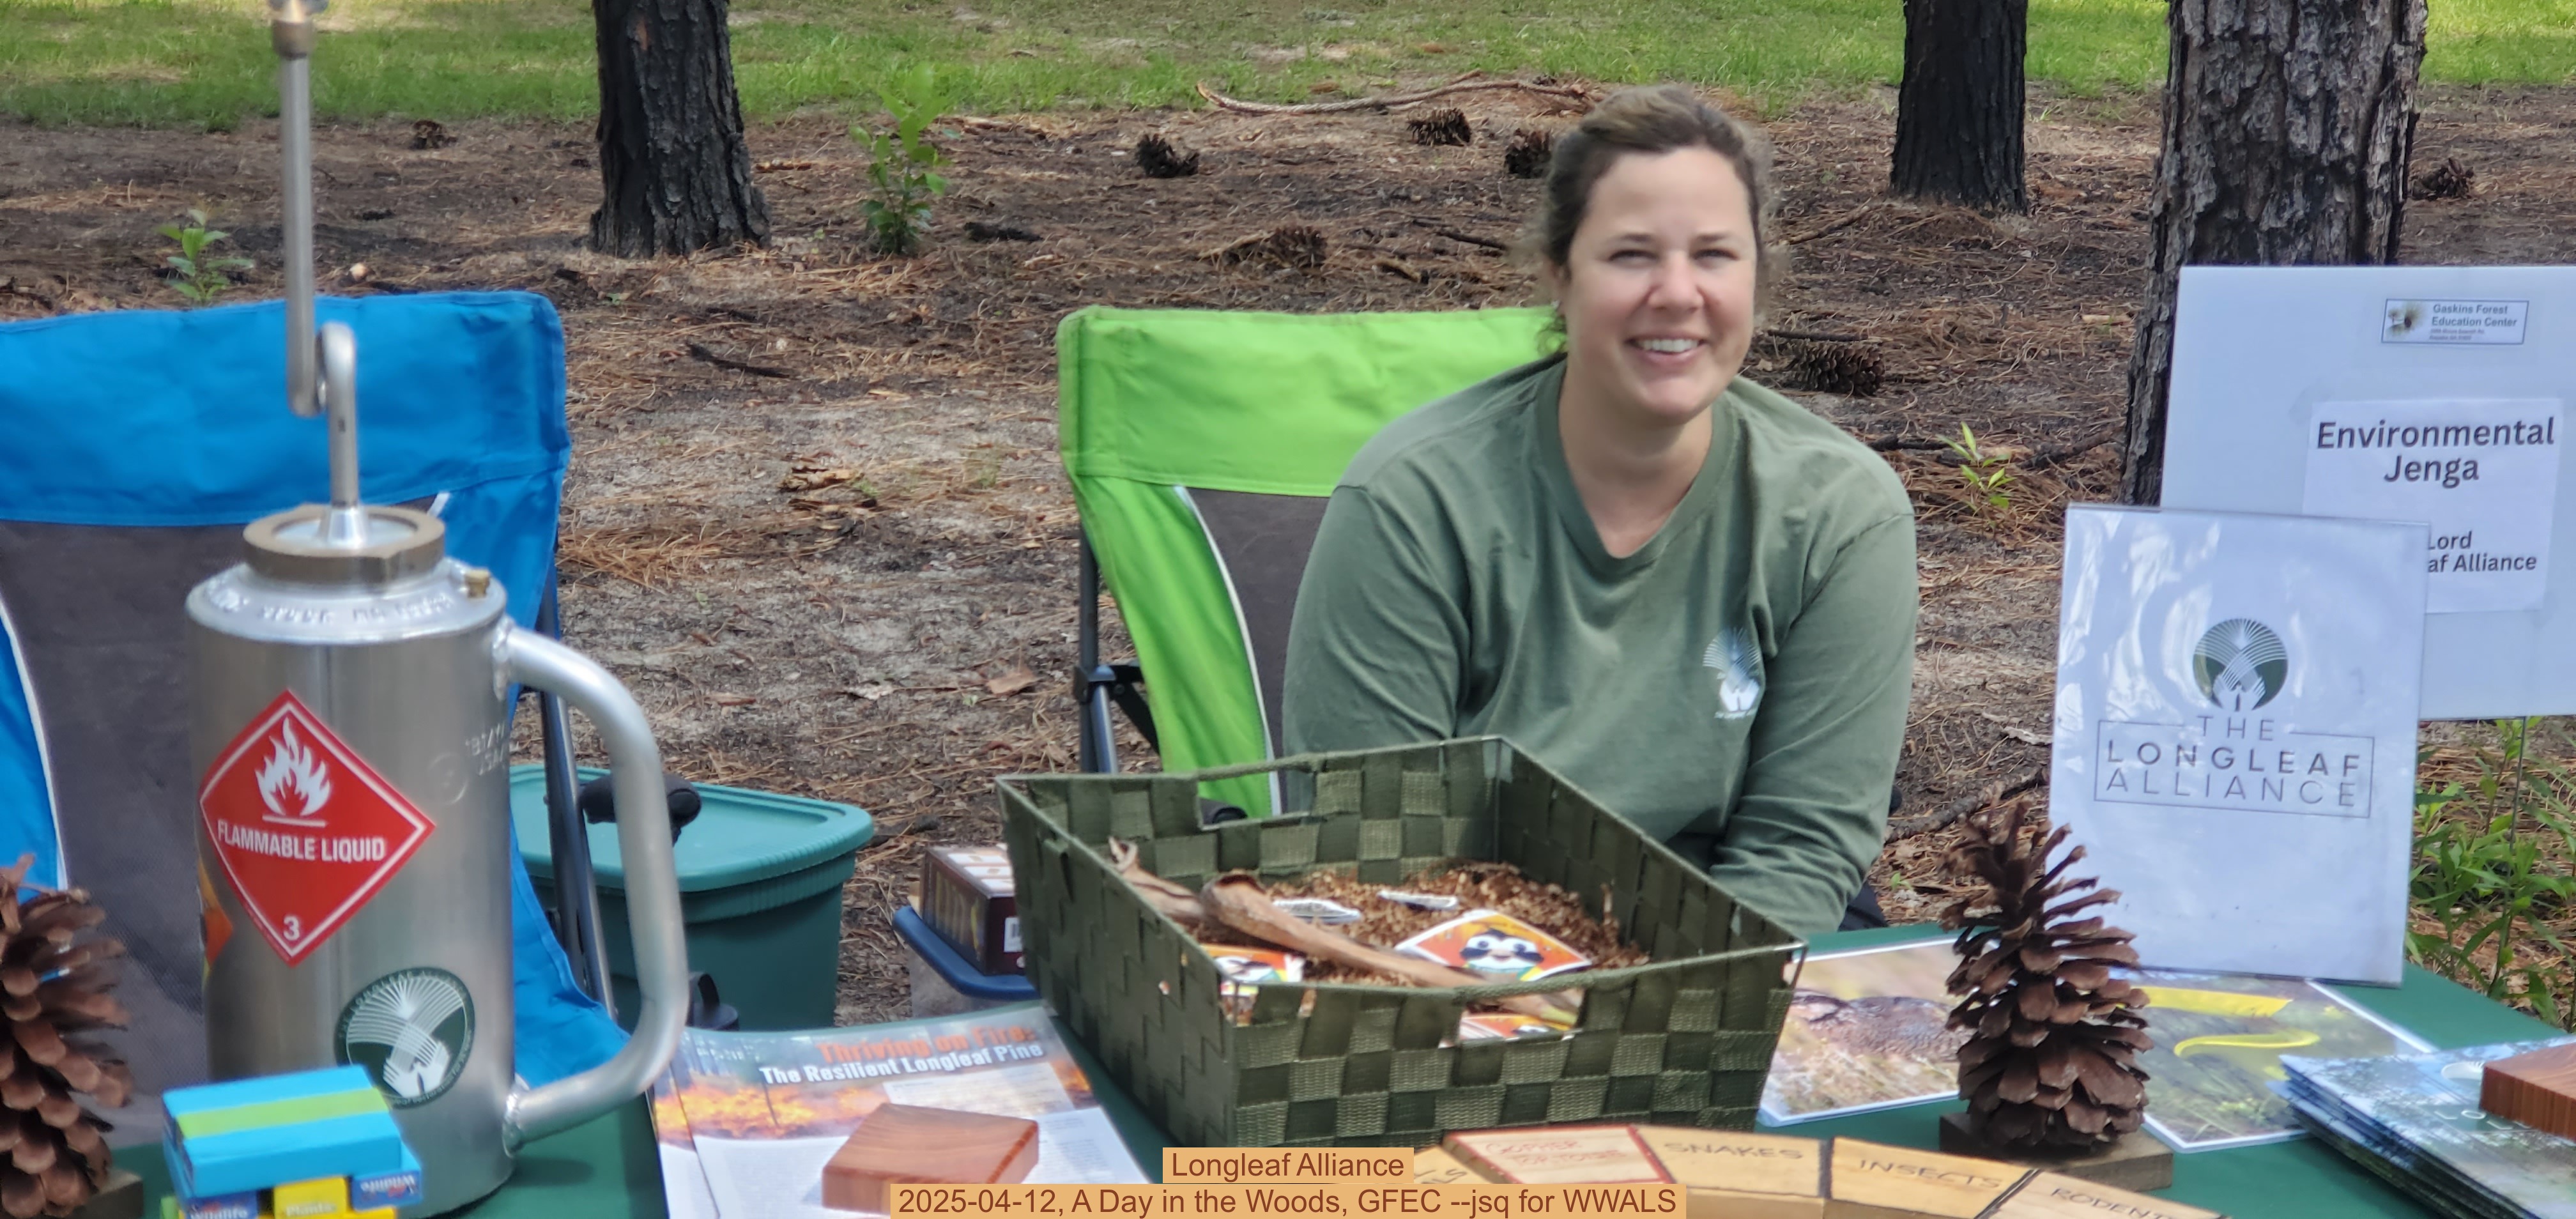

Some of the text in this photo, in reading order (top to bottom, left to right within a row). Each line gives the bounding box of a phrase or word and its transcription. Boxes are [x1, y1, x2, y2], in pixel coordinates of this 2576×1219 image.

[2432, 317, 2517, 327] Education Center
[2433, 303, 2508, 314] Gaskins Forest
[2317, 417, 2555, 448] Environmental
[2384, 454, 2480, 489] Jenga
[2453, 553, 2537, 572] Alliance
[2198, 715, 2275, 740] THE
[2108, 739, 2360, 777] LONGLEAF
[2106, 767, 2356, 807] ALLIANCE
[218, 819, 385, 862] FLAMMABLE LIQUID
[283, 916, 300, 940] 3
[815, 1025, 1036, 1062] Thriving on Fire:
[759, 1044, 1045, 1084] The Resilient Longleaf Pine
[1664, 1143, 1803, 1160] SNAKES
[1860, 1160, 2001, 1188] INSECTS
